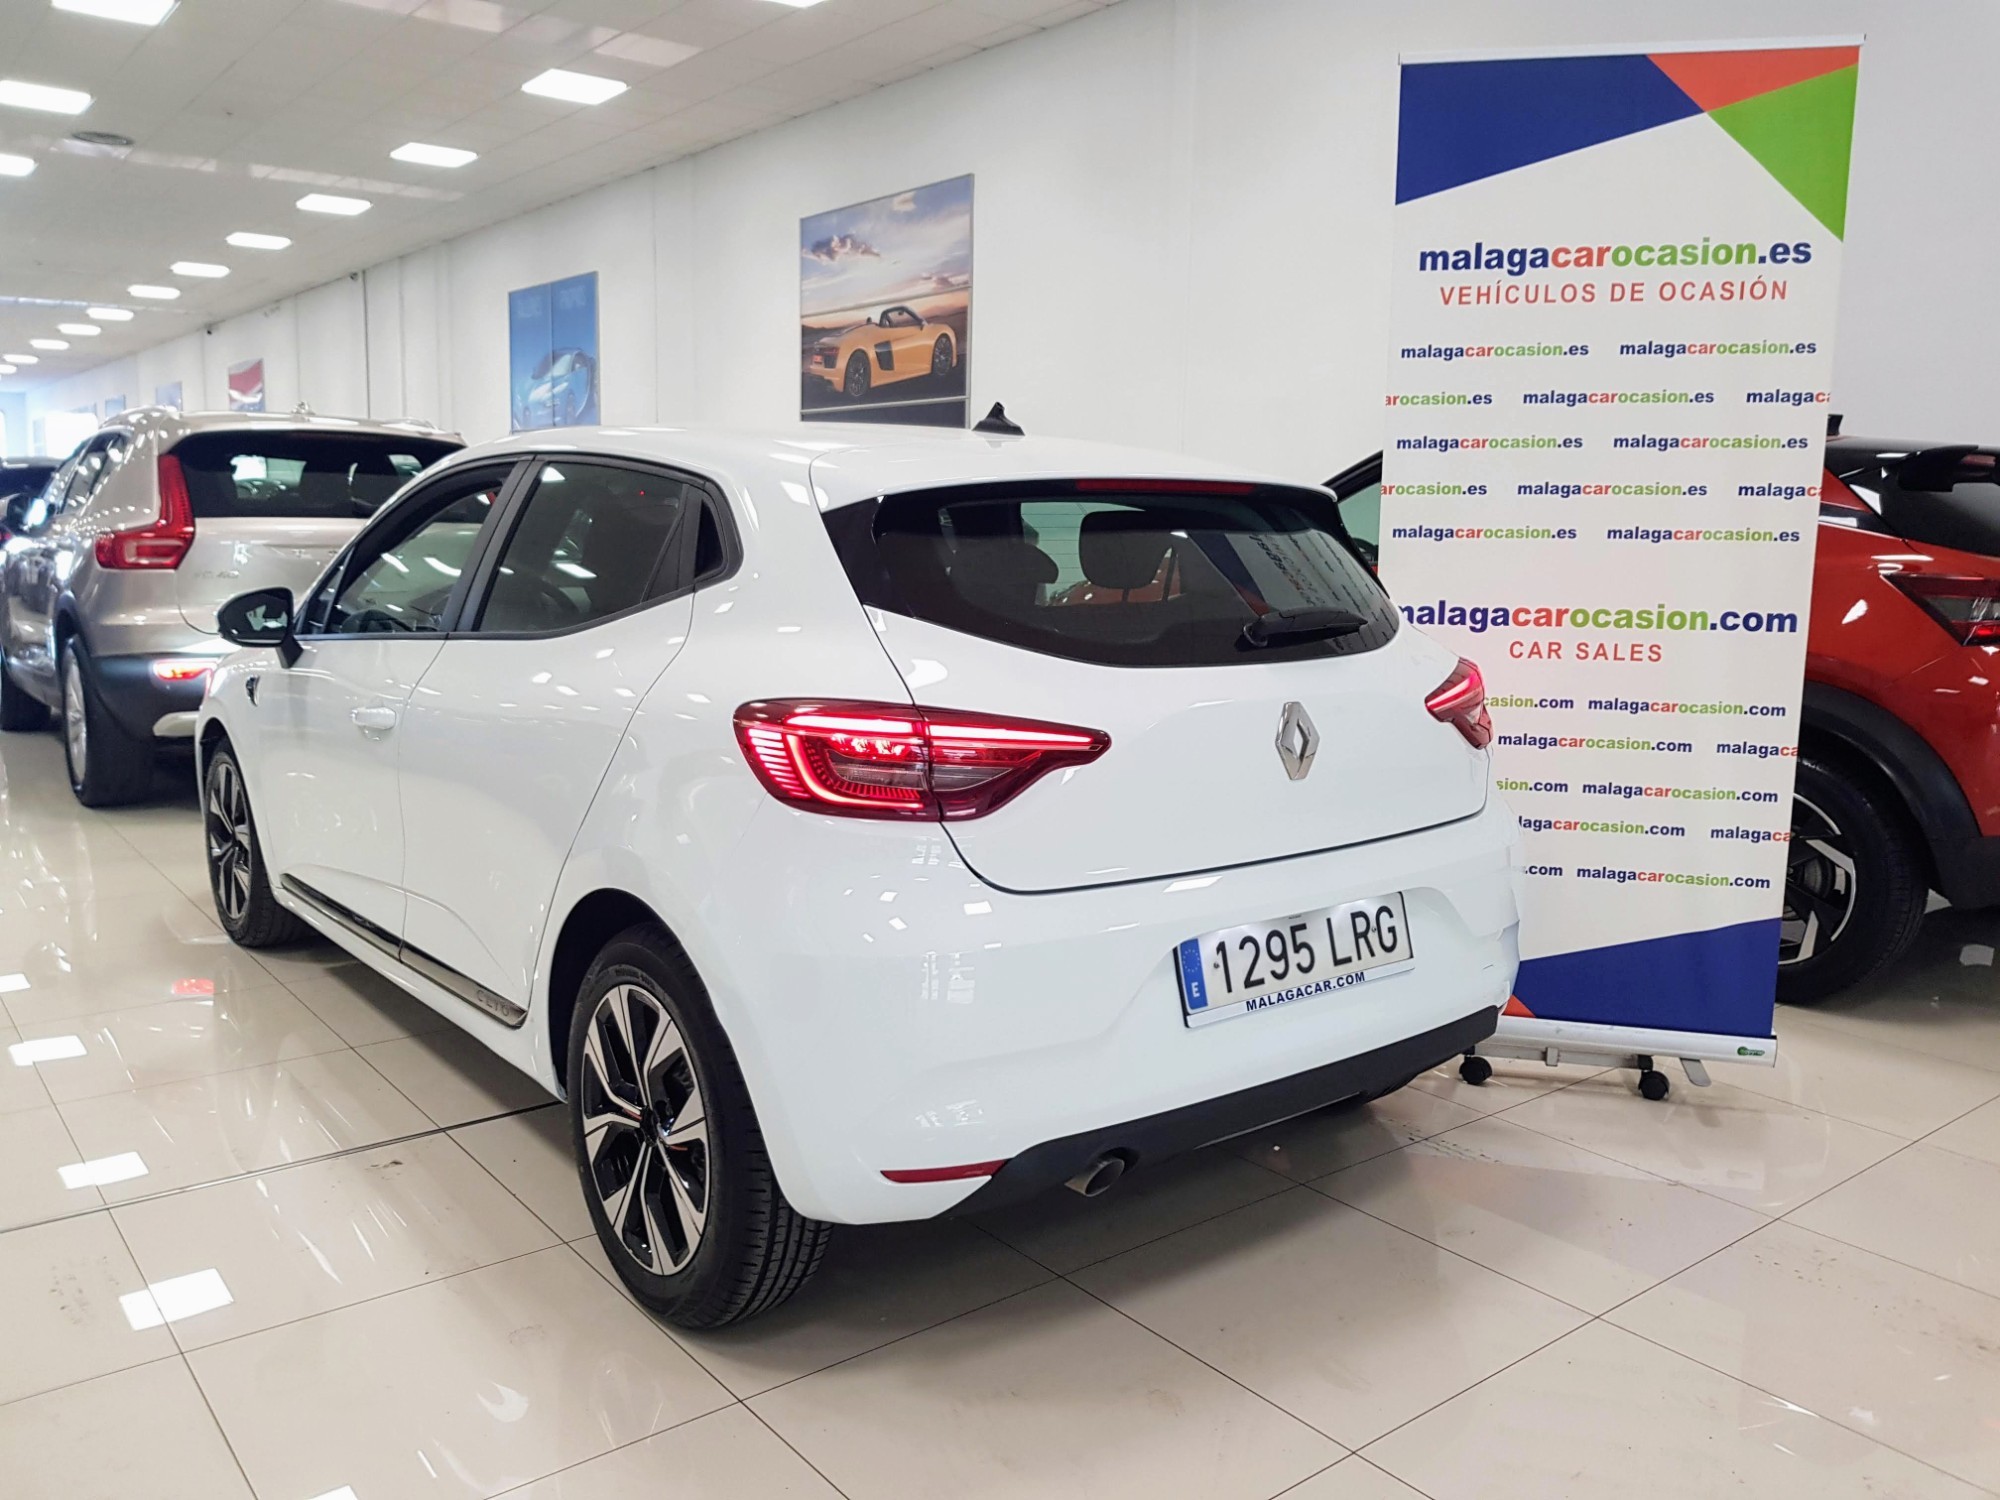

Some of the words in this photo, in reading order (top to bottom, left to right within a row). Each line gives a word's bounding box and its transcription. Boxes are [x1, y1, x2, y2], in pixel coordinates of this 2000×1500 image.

[1418, 236, 1813, 277] malagacarocasion.es
[1439, 280, 1597, 306] VEHÍCULOS
[1609, 282, 1645, 303] DE
[1658, 274, 1788, 302] OCASIÓN
[1400, 343, 1590, 361] malagacarocasion.es
[1619, 339, 1817, 358] malagacarocasion.es
[1522, 389, 1715, 407] malagacarocasion.es
[1745, 389, 1830, 407] malagac
[1396, 434, 1584, 453] malagacarocasion.es
[1613, 433, 1809, 452] malagacarocasion.es
[1517, 481, 1708, 499] malagacarocasion.es
[1392, 524, 1577, 542] malagacarocasion.es
[1607, 526, 1801, 545] malagacarocasion.es
[1509, 640, 1563, 661] CAR
[1575, 641, 1663, 663] SALES
[1588, 698, 1787, 717] malagacarocasion.com
[1498, 732, 1693, 753] malagacarocasion.com
[1582, 782, 1779, 803] malagacarocasion.com
[1576, 866, 1771, 889] malagacarocasion.com
[1215, 922, 1315, 994] 1295
[1326, 905, 1398, 967] LRG
[1191, 981, 1201, 998] E
[1245, 971, 1366, 1012] MALAGACAR.COM
